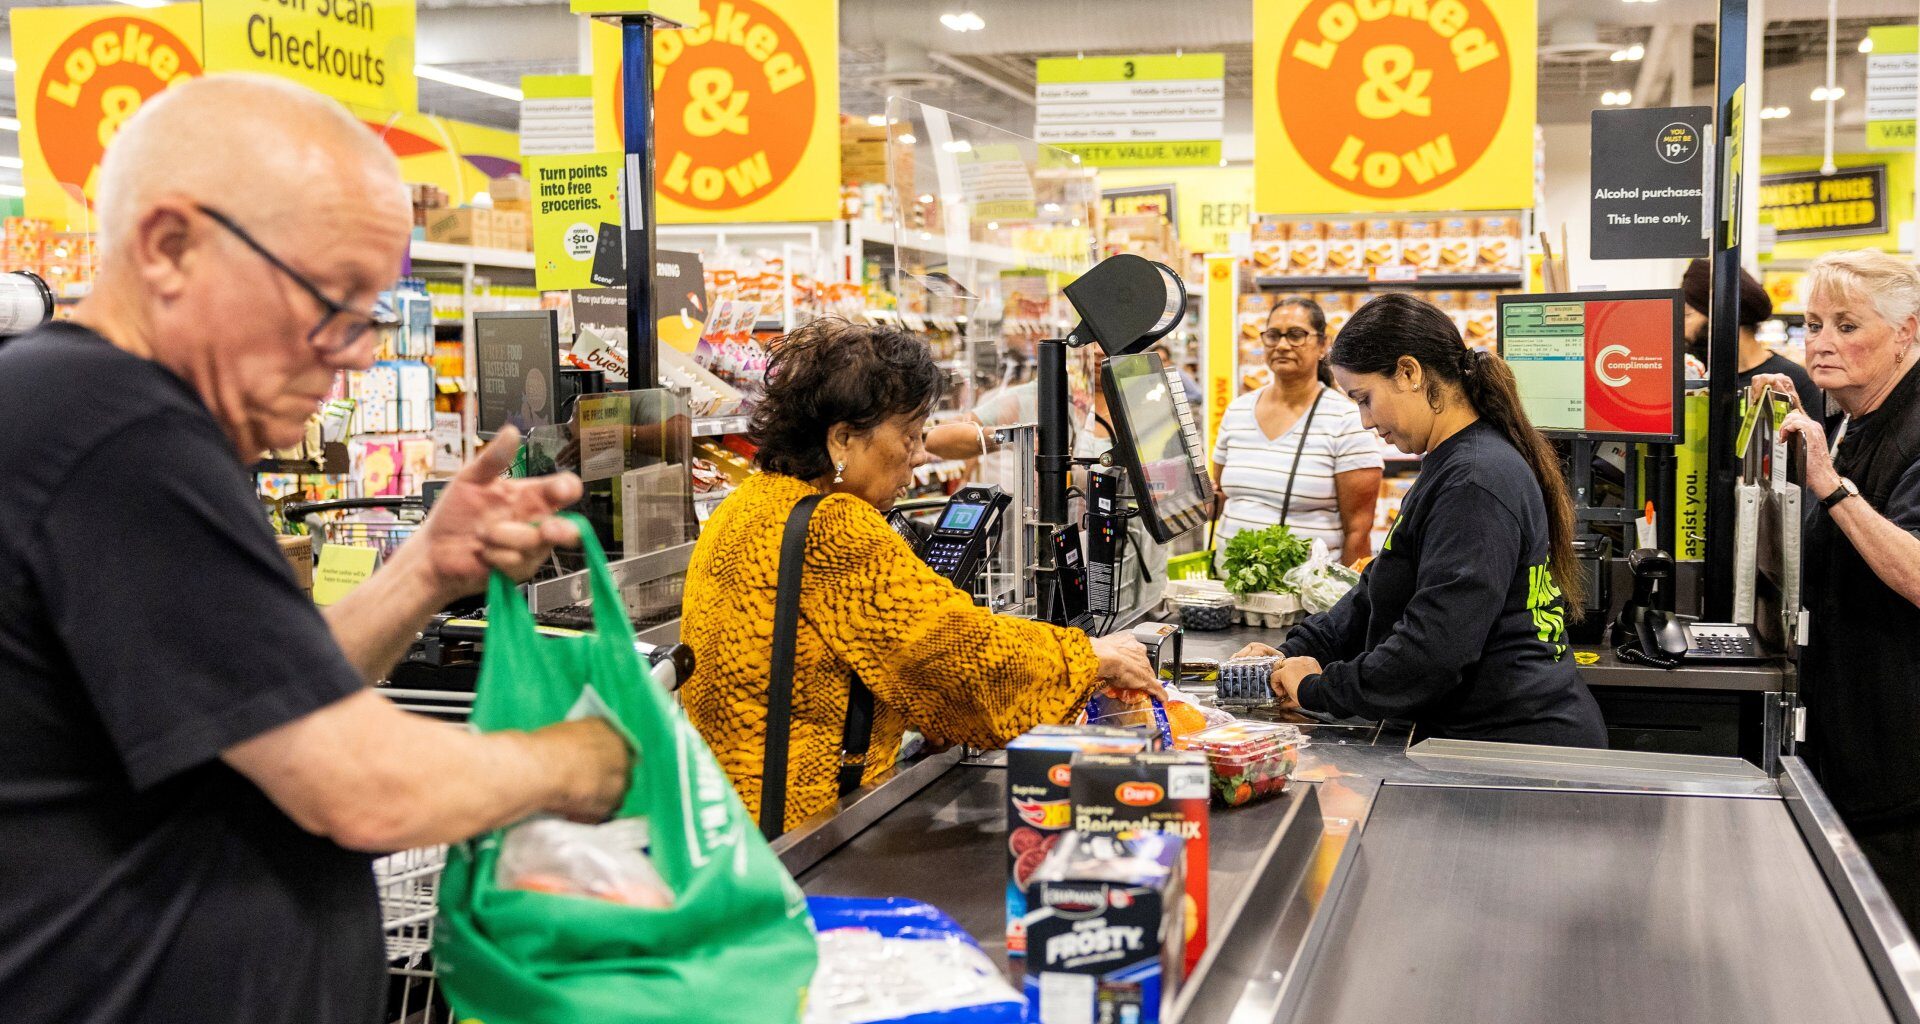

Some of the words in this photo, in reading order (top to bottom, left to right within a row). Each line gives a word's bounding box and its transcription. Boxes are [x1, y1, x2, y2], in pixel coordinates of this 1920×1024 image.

[247, 13, 385, 87] Checkouts
[1124, 61, 1136, 79] 3
[1355, 44, 1433, 119] &
[682, 66, 750, 137] &
[1666, 143, 1689, 157] 19+
[1329, 132, 1457, 189] Low
[540, 168, 566, 181] Turn
[569, 165, 608, 181] points
[662, 150, 773, 201] Low
[541, 183, 565, 196] into
[568, 182, 592, 195] free
[1594, 187, 1639, 200] Alcohol
[1642, 187, 1703, 201] purchases.
[542, 197, 602, 214] groceries.
[1607, 213, 1631, 225] This
[1634, 213, 1659, 224] lane
[1663, 213, 1691, 226] only.
[573, 234, 595, 245] $10
[587, 348, 628, 380] bueno
[1607, 361, 1662, 370] compliments
[1686, 469, 1701, 506] you.
[1682, 510, 1698, 557] assist
[1123, 786, 1156, 801] Dare
